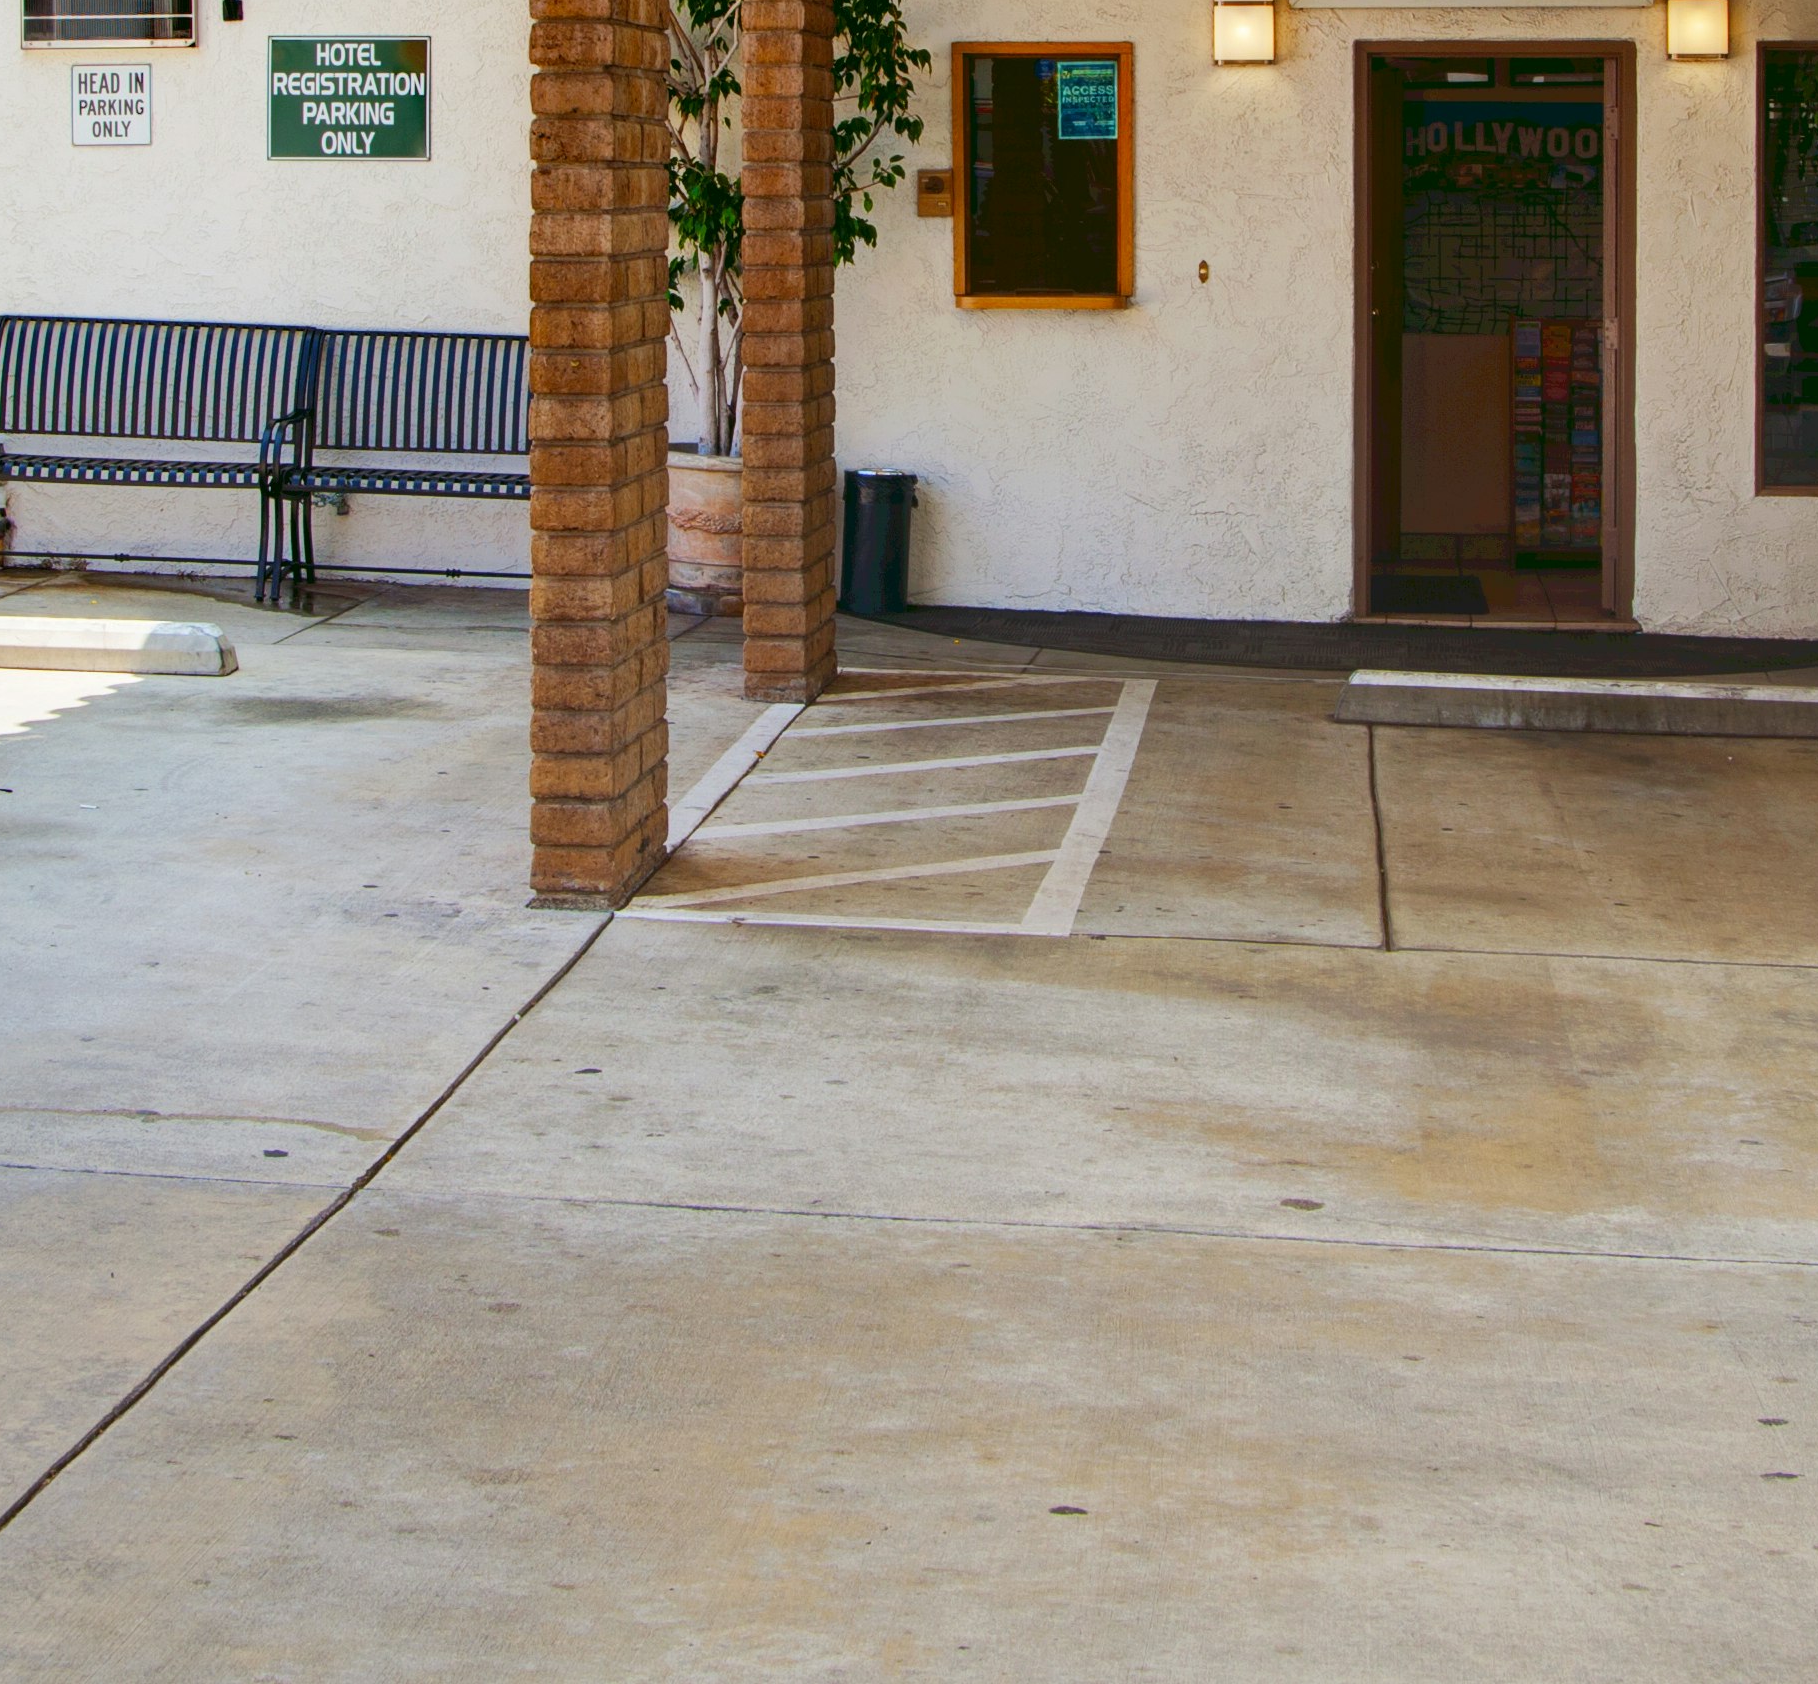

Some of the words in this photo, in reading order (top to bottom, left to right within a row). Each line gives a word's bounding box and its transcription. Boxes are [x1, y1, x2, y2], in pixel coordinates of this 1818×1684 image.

[316, 43, 382, 66] HOTEL
[78, 73, 120, 94] HEAD
[129, 72, 144, 94] IN
[272, 72, 425, 96] REGISTRATION
[1063, 85, 1114, 96] ACCESS
[79, 99, 144, 116] PARKING
[302, 102, 395, 125] PARKING
[92, 120, 131, 138] ONLY
[1406, 121, 1598, 158] HOLLYWOO
[321, 131, 375, 155] ONLY
